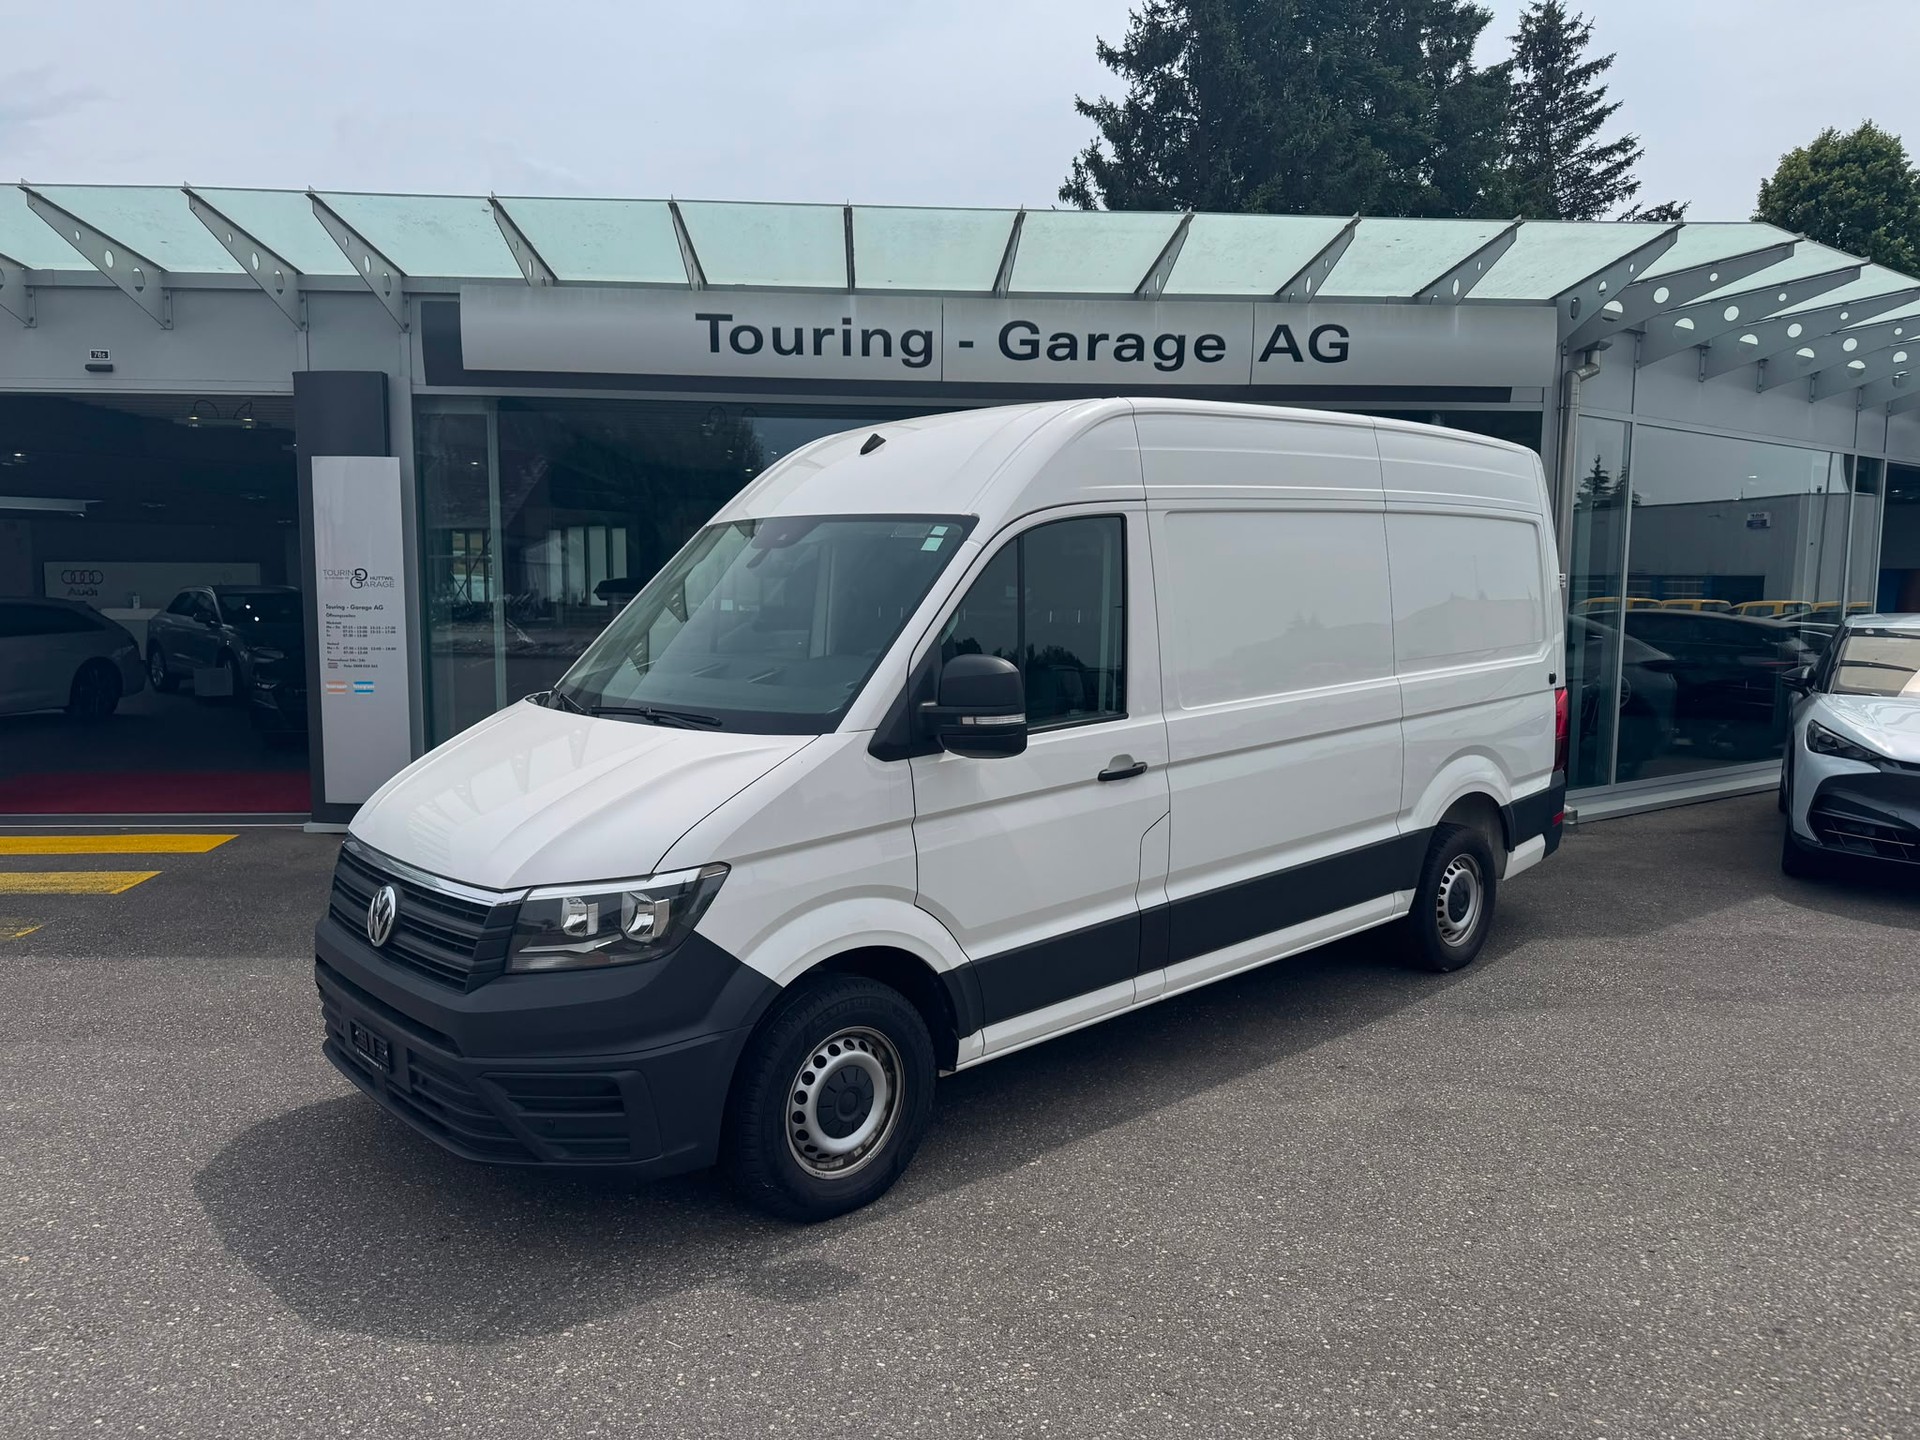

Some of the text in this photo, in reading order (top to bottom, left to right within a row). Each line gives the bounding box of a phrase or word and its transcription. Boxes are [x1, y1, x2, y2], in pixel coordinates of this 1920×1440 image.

[695, 312, 934, 368] Touring
[999, 319, 1227, 371] Garage
[1258, 323, 1350, 364] AG
[67, 587, 98, 597] Audi
[325, 603, 345, 611] Touring
